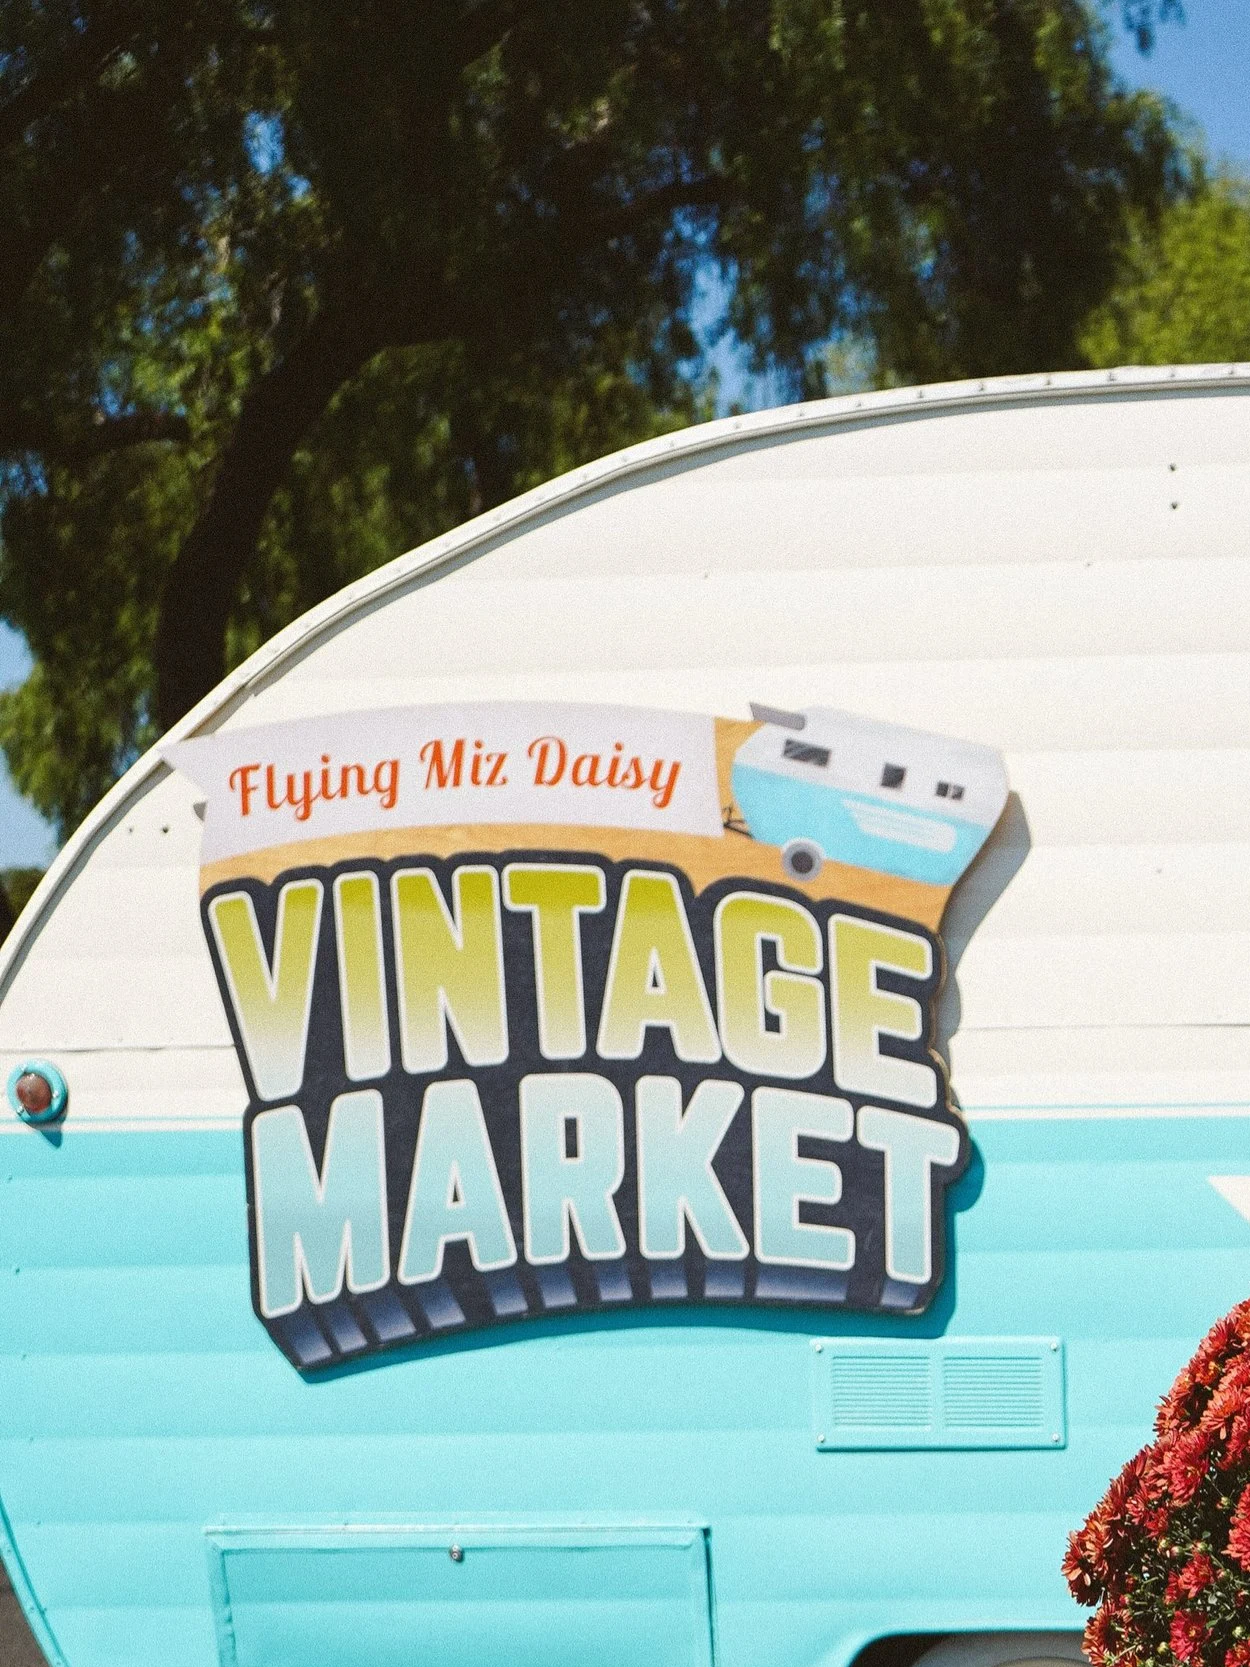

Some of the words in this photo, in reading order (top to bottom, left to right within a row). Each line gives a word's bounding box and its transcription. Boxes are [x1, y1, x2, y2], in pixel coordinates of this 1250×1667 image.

[229, 754, 400, 821] Flying
[419, 739, 509, 790] Miz
[527, 736, 682, 807] Daisy
[208, 863, 938, 1107] VINTAGE
[250, 1072, 961, 1319] MARKET
